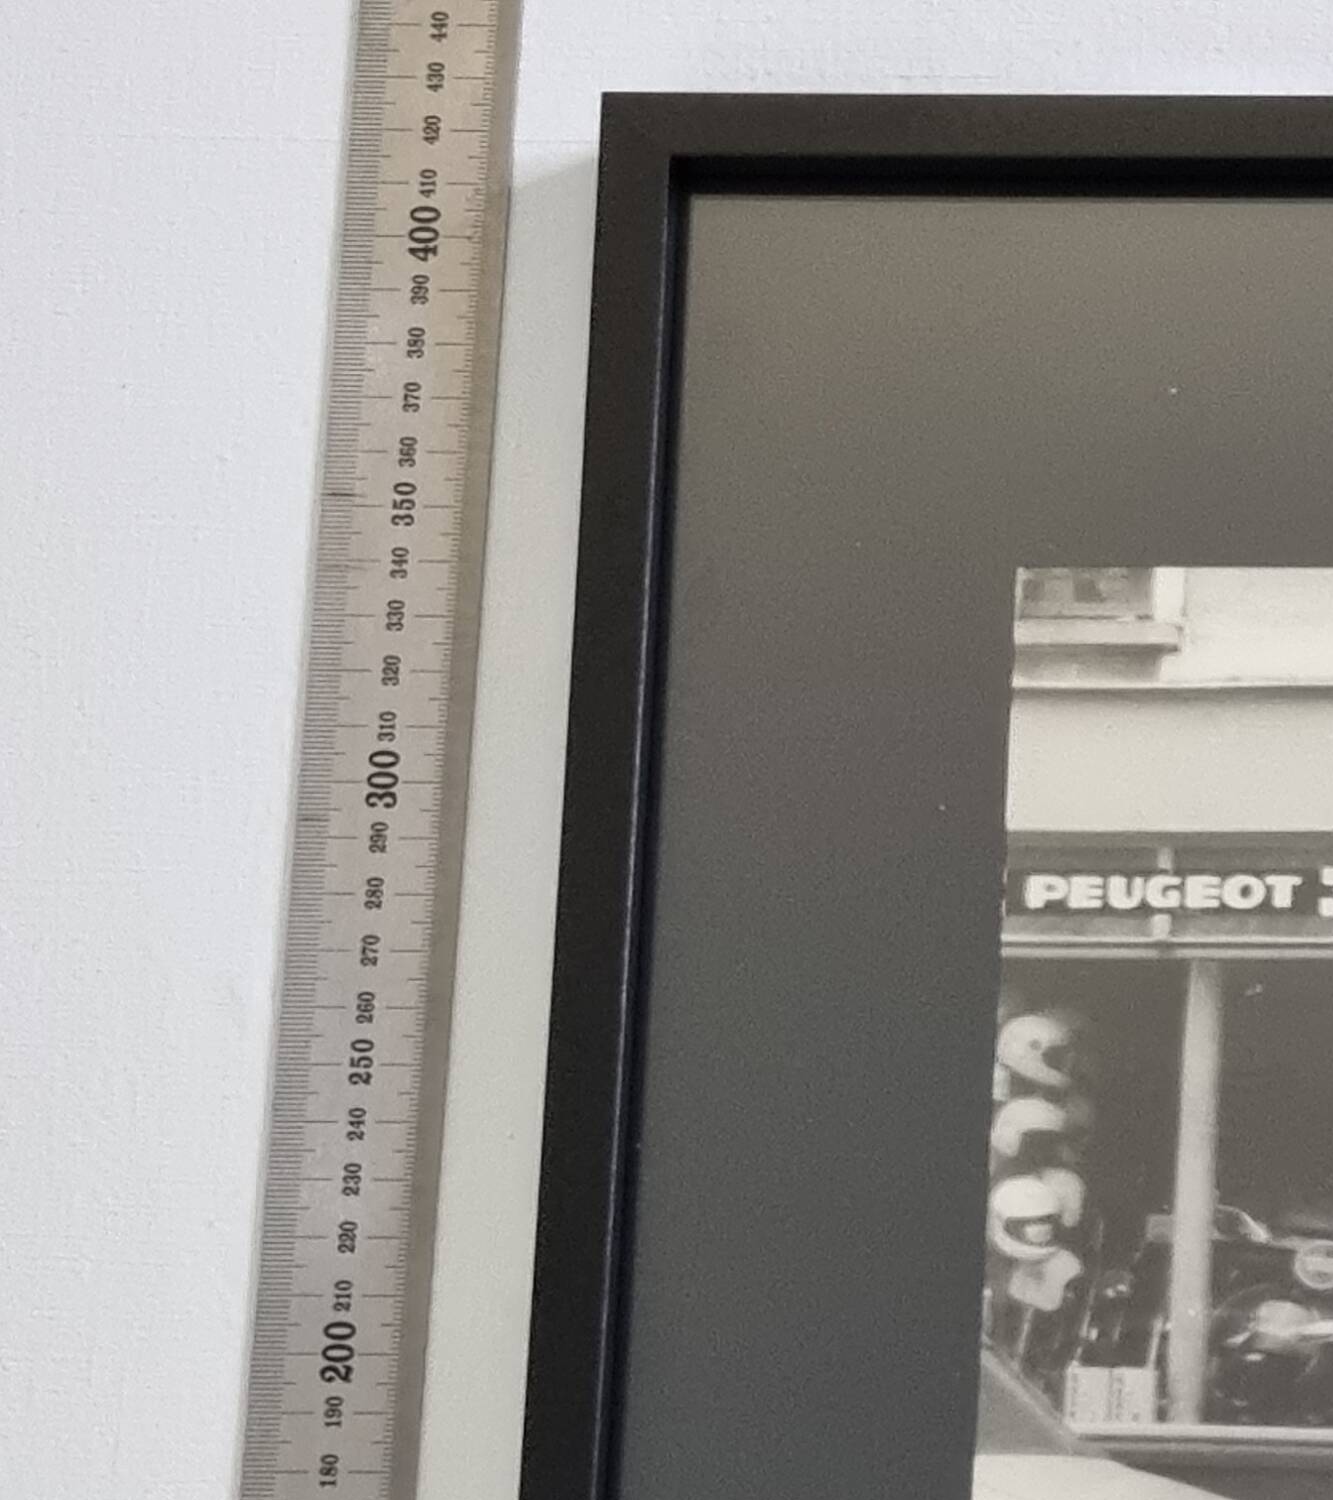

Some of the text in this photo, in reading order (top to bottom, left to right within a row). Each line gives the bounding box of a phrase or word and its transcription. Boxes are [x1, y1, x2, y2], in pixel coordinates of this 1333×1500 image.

[429, 11, 449, 43] 440
[426, 62, 445, 92] 430
[422, 115, 442, 145] 420
[418, 168, 437, 198] 410
[407, 205, 441, 262] 400
[410, 274, 430, 305] 390
[406, 327, 426, 359] 380
[402, 382, 422, 413] 370
[397, 436, 418, 468] 360
[390, 482, 417, 527] 350
[389, 547, 409, 579] 340
[385, 599, 405, 631] 330
[381, 654, 401, 686] 320
[377, 711, 397, 742] 310
[364, 749, 400, 809] 300
[368, 821, 389, 854] 290
[364, 876, 384, 910] 280
[1024, 874, 1303, 909] PEUGEOT
[359, 934, 381, 967] 270
[355, 991, 376, 1024] 260
[347, 1038, 375, 1086] 250
[346, 1107, 367, 1141] 240
[341, 1162, 362, 1197] 230
[337, 1220, 358, 1254] 220
[332, 1279, 353, 1312] 210
[319, 1320, 357, 1383] 200
[323, 1396, 344, 1427] 190
[318, 1454, 339, 1487] 180
